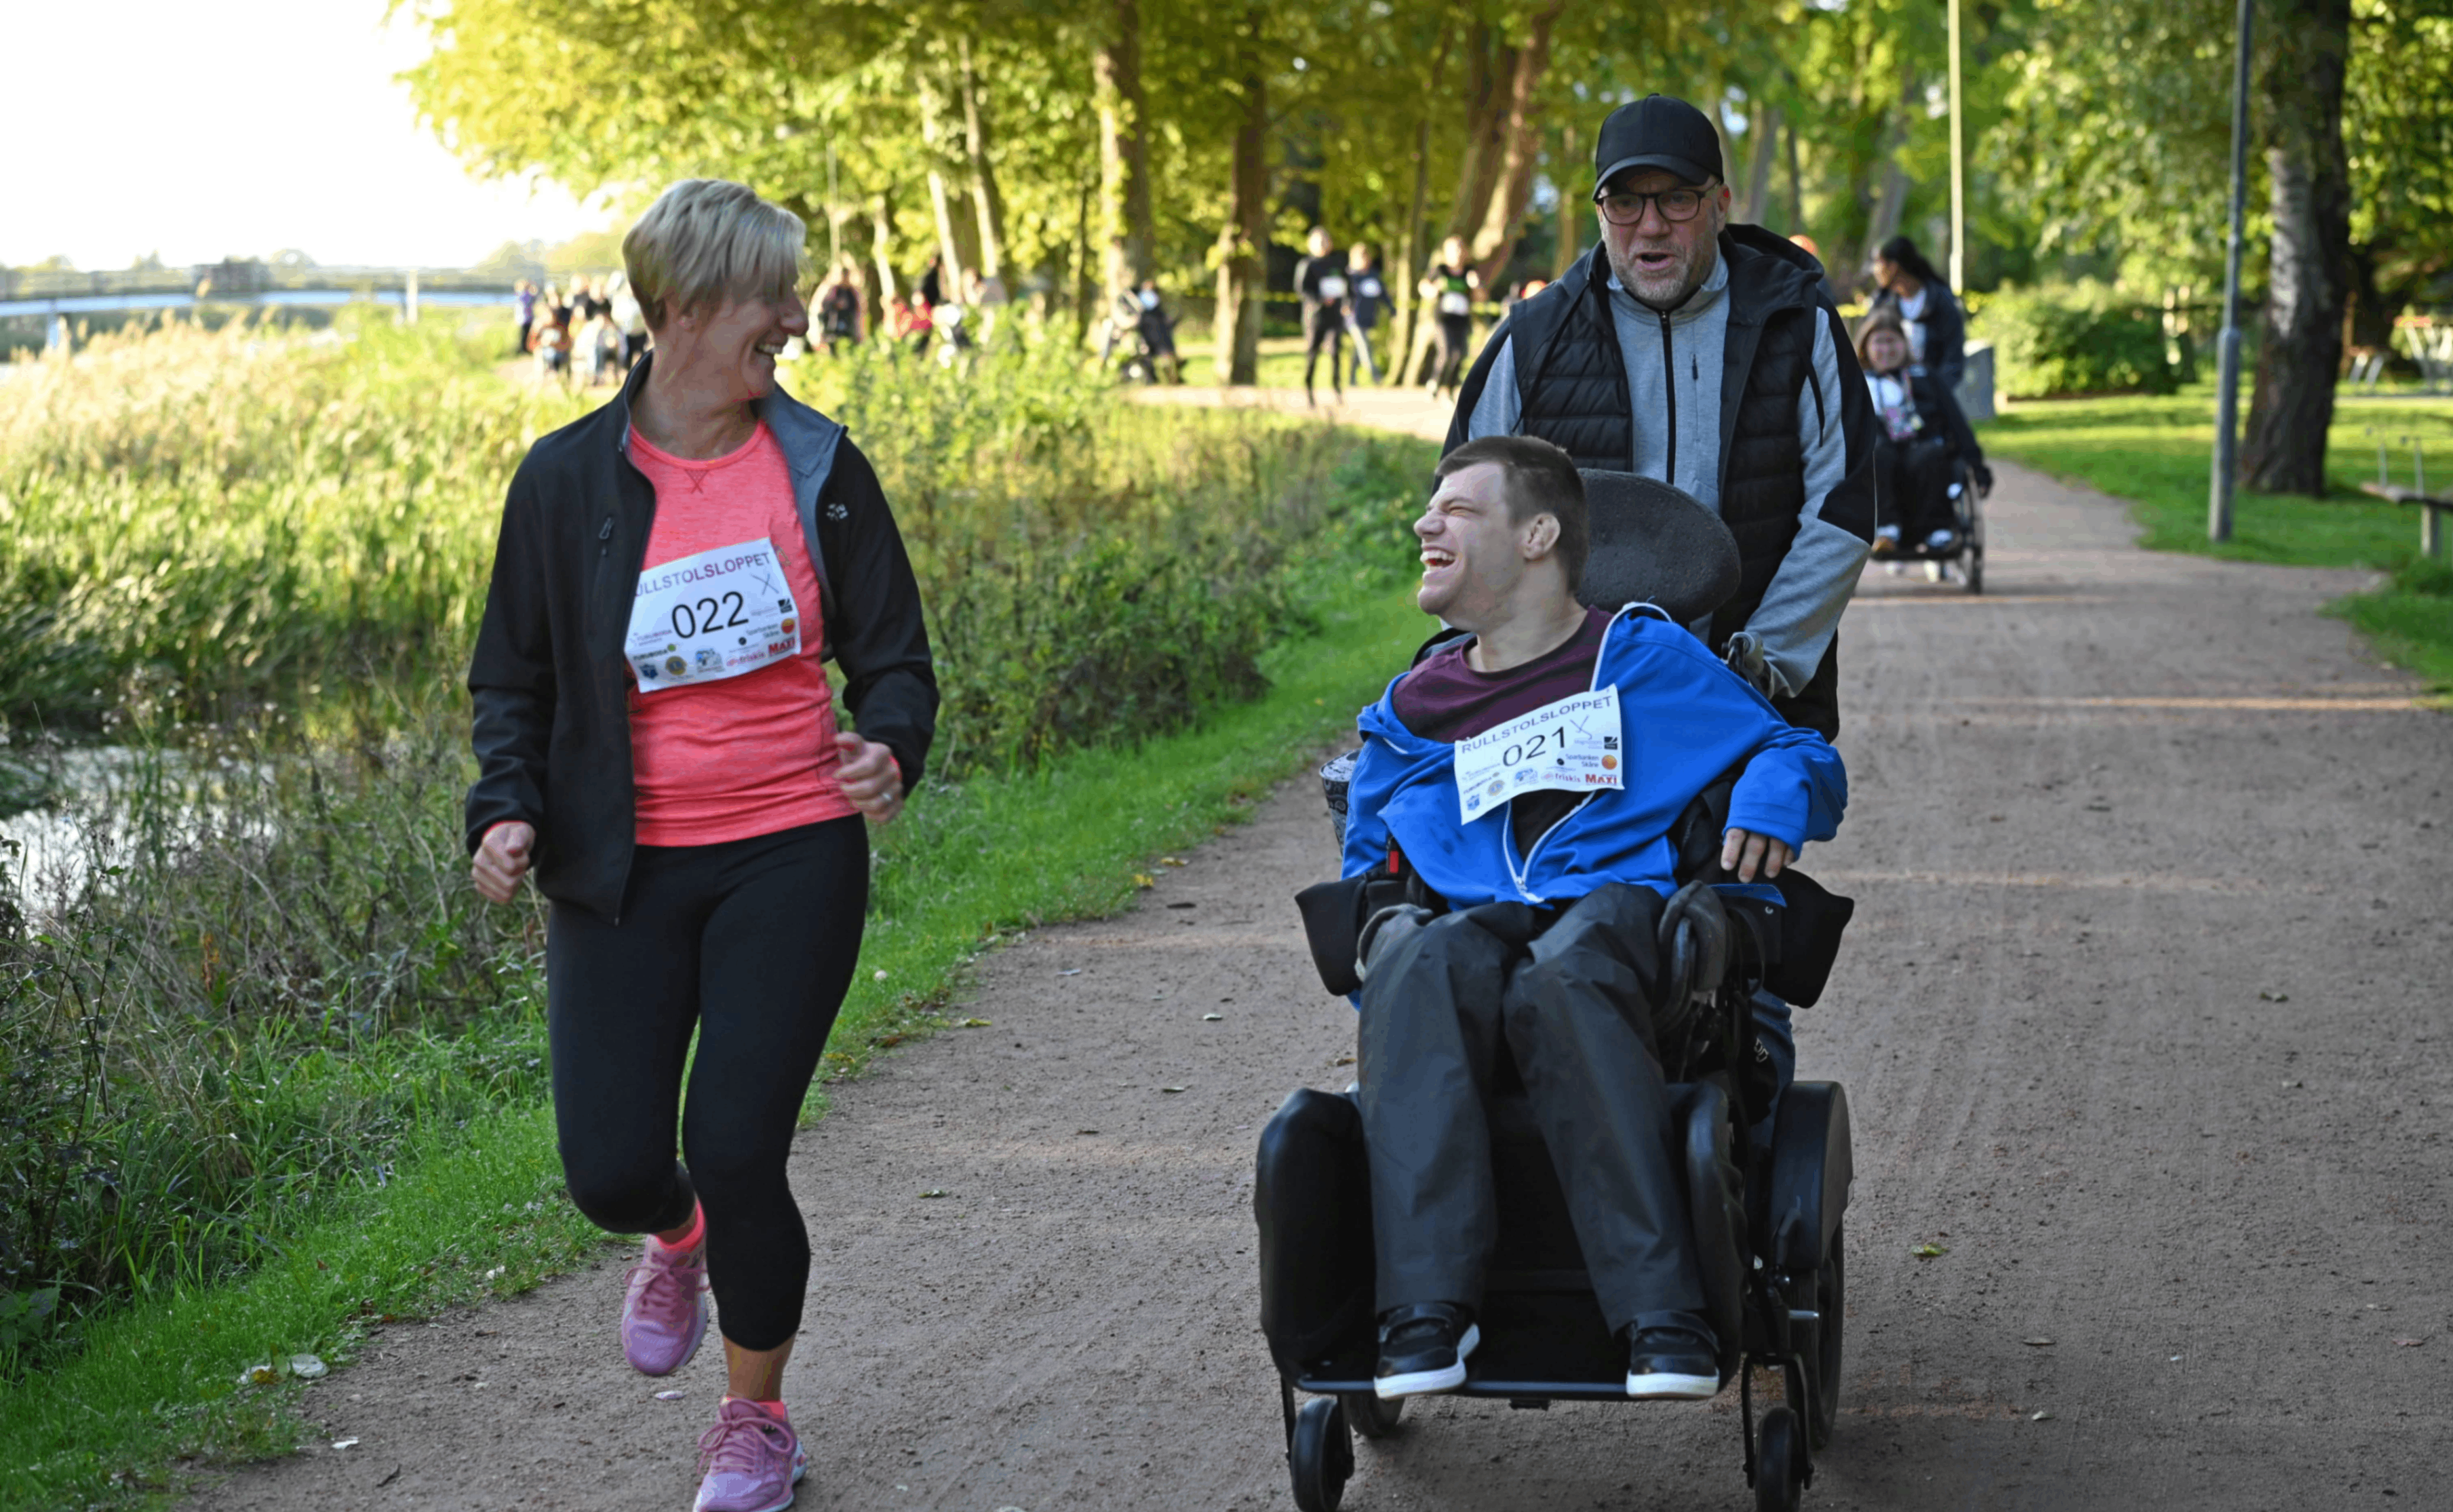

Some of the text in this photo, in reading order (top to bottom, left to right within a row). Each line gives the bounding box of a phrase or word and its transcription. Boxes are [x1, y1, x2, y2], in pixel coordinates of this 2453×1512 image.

[635, 552, 770, 597] ULLSTOLSLOPPET
[671, 591, 749, 639] 022
[1461, 695, 1613, 754] RULLSTOLSLOPPET
[1502, 725, 1565, 767] 021
